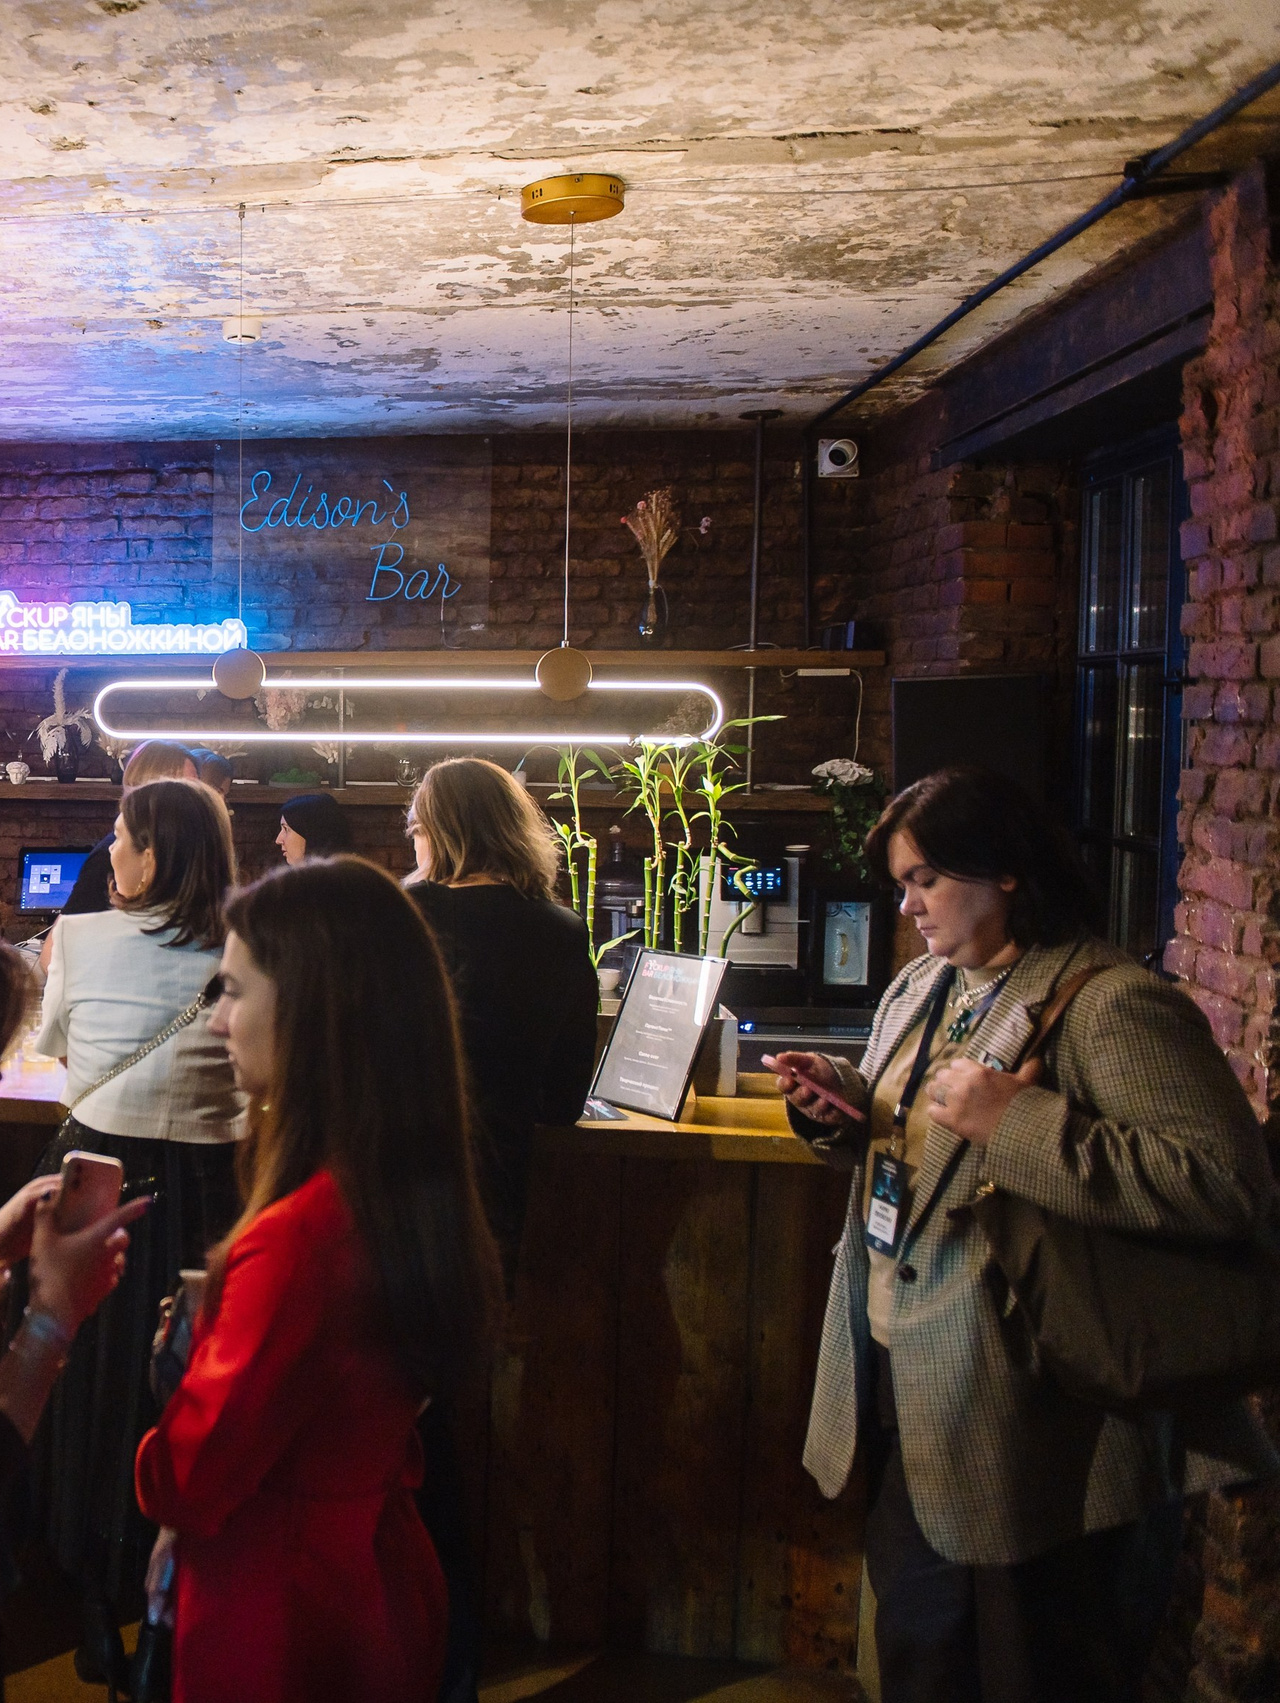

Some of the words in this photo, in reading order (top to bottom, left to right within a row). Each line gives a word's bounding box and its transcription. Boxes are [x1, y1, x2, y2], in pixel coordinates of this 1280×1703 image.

[365, 542, 461, 601] Bar
[71, 605, 127, 629] ЯНЫ
[22, 623, 242, 651] БЕЛОНОЖКИНОЙ
